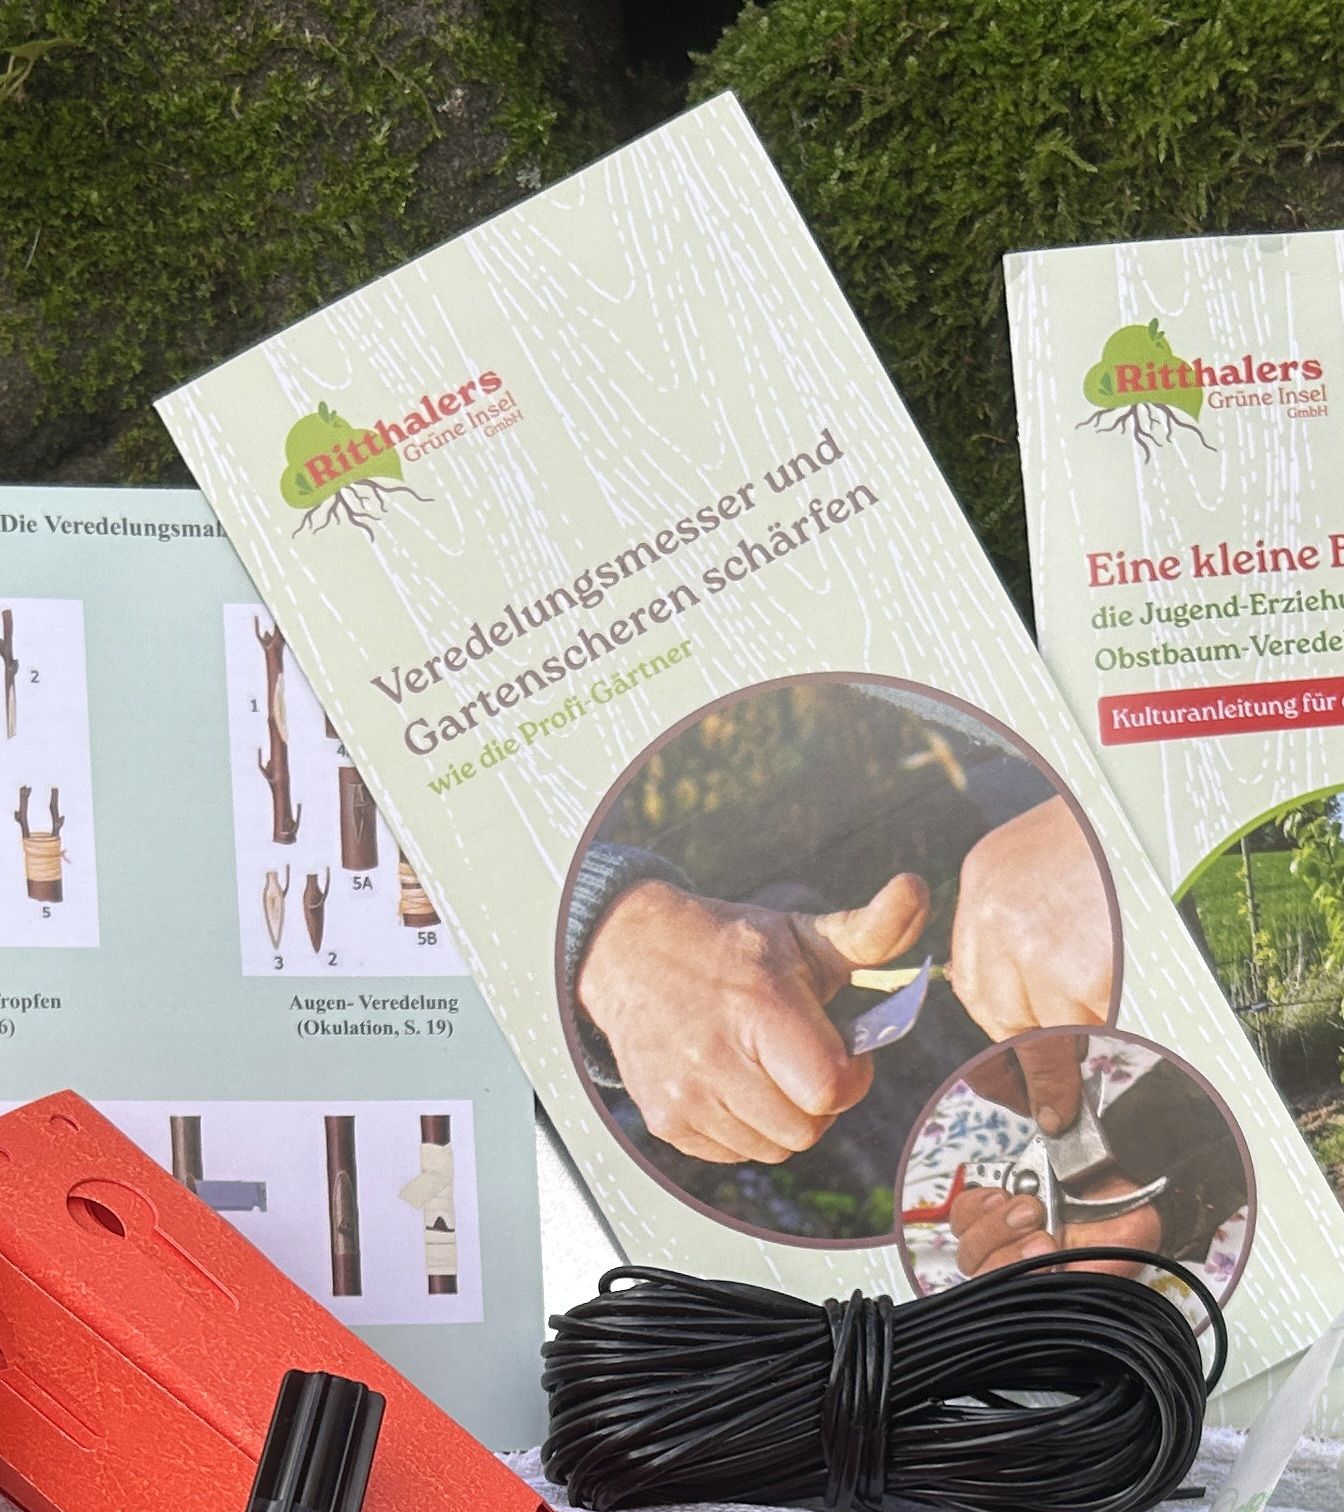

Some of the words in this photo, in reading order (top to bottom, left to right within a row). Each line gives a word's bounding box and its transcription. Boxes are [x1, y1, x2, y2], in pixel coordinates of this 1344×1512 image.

[1116, 355, 1323, 394] Ritthalers
[1207, 387, 1273, 411] Grüne
[1278, 384, 1327, 405] Insel
[1286, 405, 1328, 419] GmbH
[304, 369, 504, 490] Ritthalers
[402, 420, 464, 464] Grüne
[463, 391, 518, 436] Insel
[484, 411, 524, 439] GmbH
[0, 514, 39, 534] Die
[370, 478, 758, 706] Veredelungsmesser
[764, 428, 845, 495] und
[1086, 550, 1181, 587] Eine
[1191, 539, 1320, 578] kleine
[403, 578, 701, 755] Gartenscheren
[703, 480, 879, 595] schärfen
[1091, 605, 1133, 630] die
[30, 670, 40, 684] 2
[250, 700, 258, 712] 1
[427, 756, 476, 797] wie
[479, 732, 520, 770] die
[519, 636, 694, 748] Profi-Gärtner
[1111, 694, 1297, 730] Kulturanleitung
[1302, 690, 1337, 714] für
[353, 877, 373, 892] 5A
[42, 906, 51, 919] 5
[417, 932, 437, 946] 5B
[274, 957, 284, 971] 3
[328, 953, 338, 967] 2
[290, 995, 353, 1014] Augen-
[358, 994, 459, 1016] Veredelung
[296, 1019, 399, 1039] (Okulation,
[404, 1020, 422, 1035] S.
[426, 1018, 454, 1039] 19)
